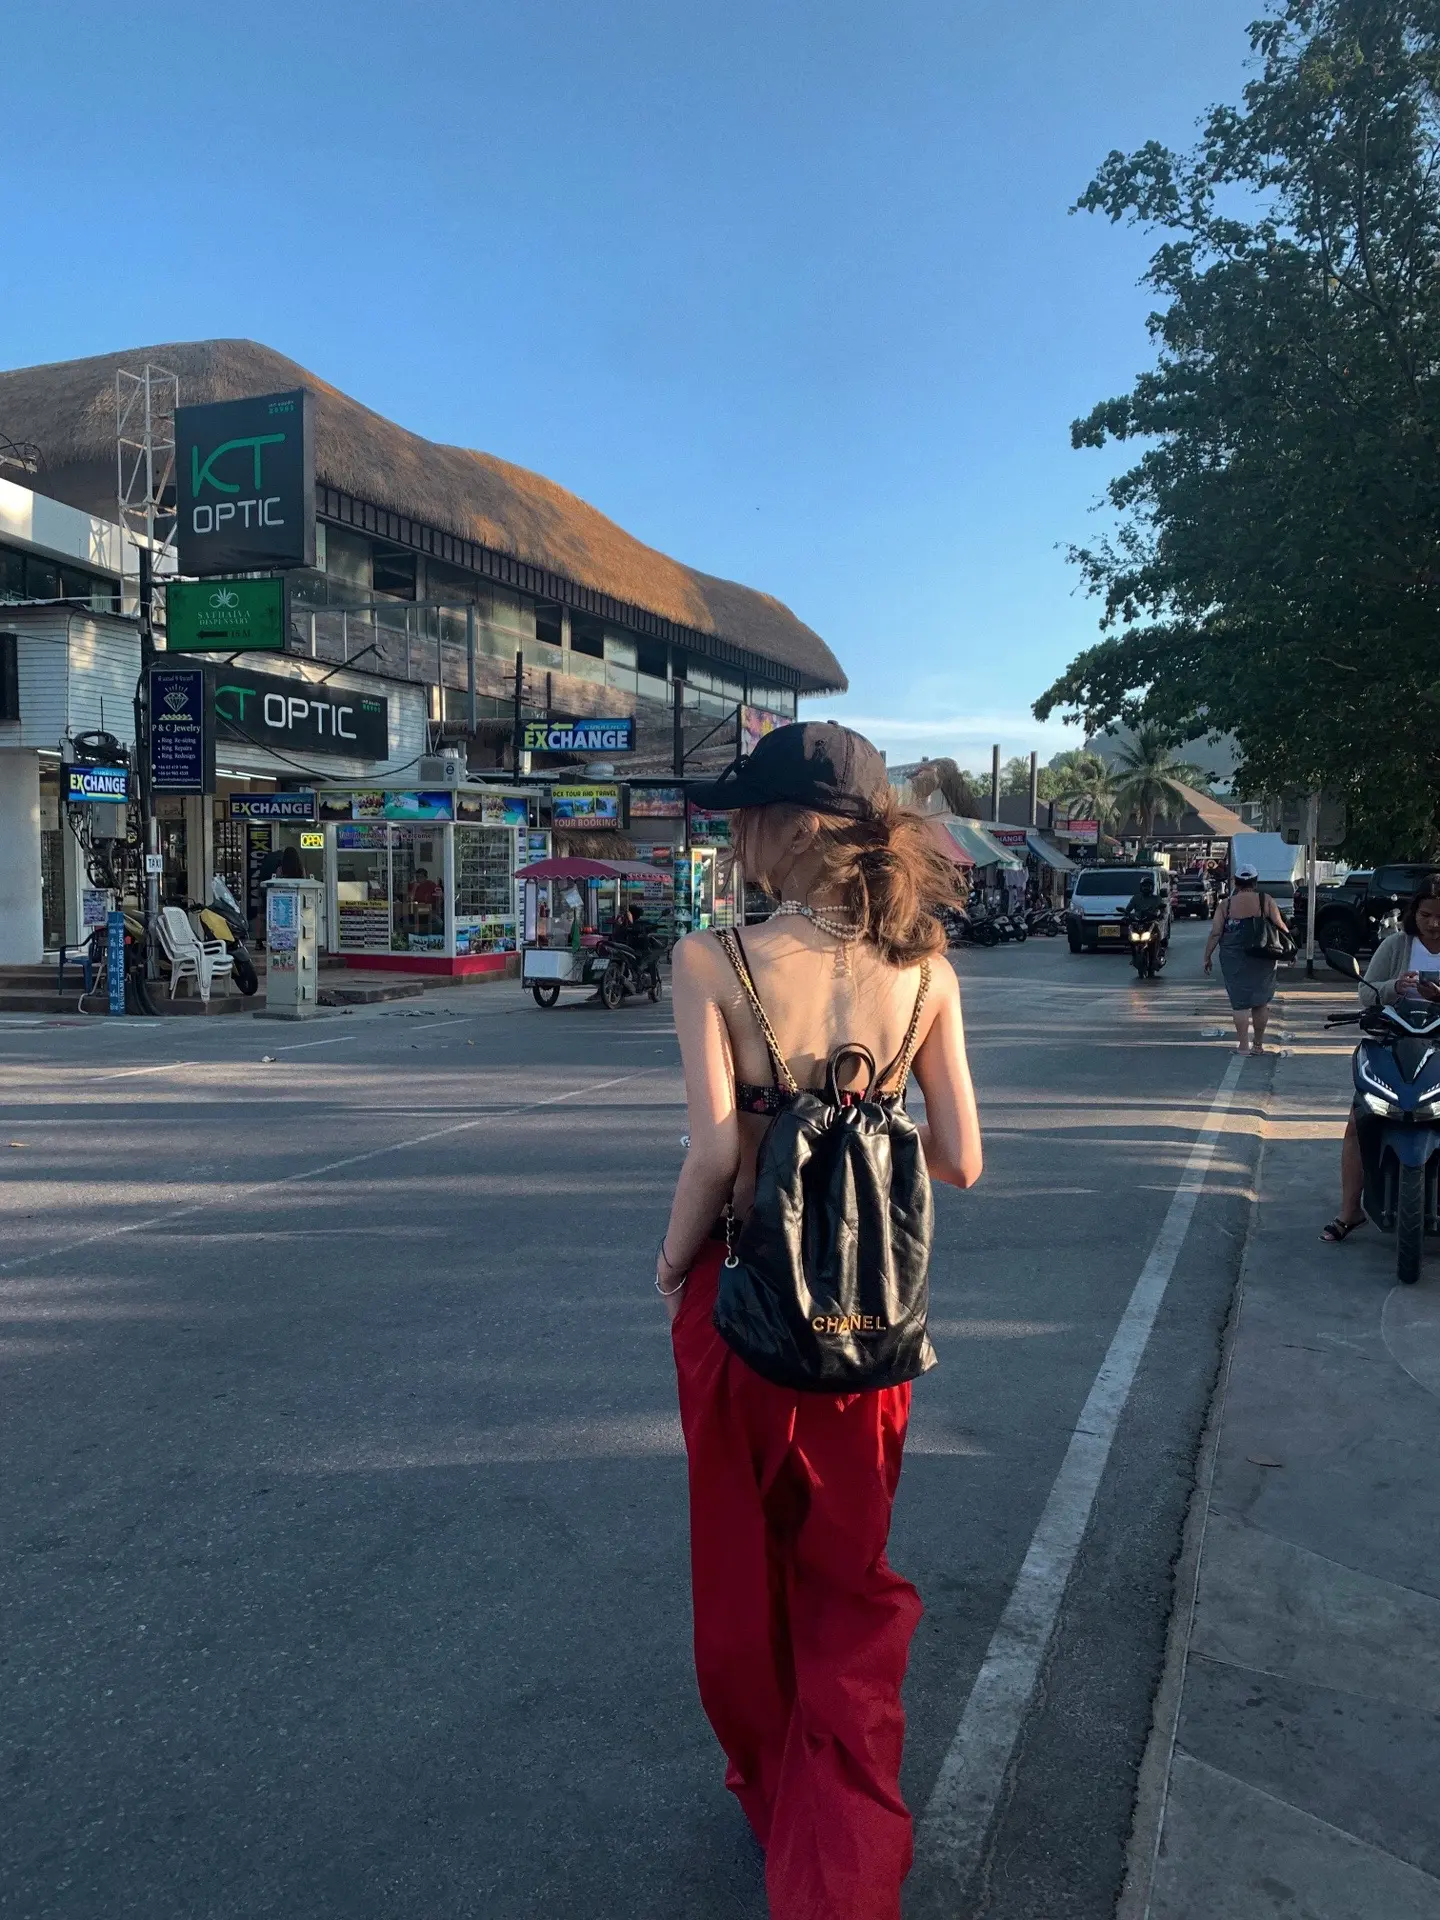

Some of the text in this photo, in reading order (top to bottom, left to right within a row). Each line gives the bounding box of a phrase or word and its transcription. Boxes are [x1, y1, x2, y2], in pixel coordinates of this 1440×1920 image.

[192, 433, 286, 497] KT
[193, 497, 285, 533] OPTIC
[199, 617, 249, 625] DISPENSARY
[264, 693, 357, 739] OPTIC
[173, 723, 201, 734] Jewelry
[524, 731, 628, 749] EXCHANGE
[70, 773, 126, 795] EXCHANGE
[595, 789, 616, 797] TRAVEL
[232, 802, 312, 816] EXCHANGE
[578, 818, 617, 827] BOOKING
[302, 835, 322, 846] OPEN
[812, 1314, 887, 1334] CHANEL
